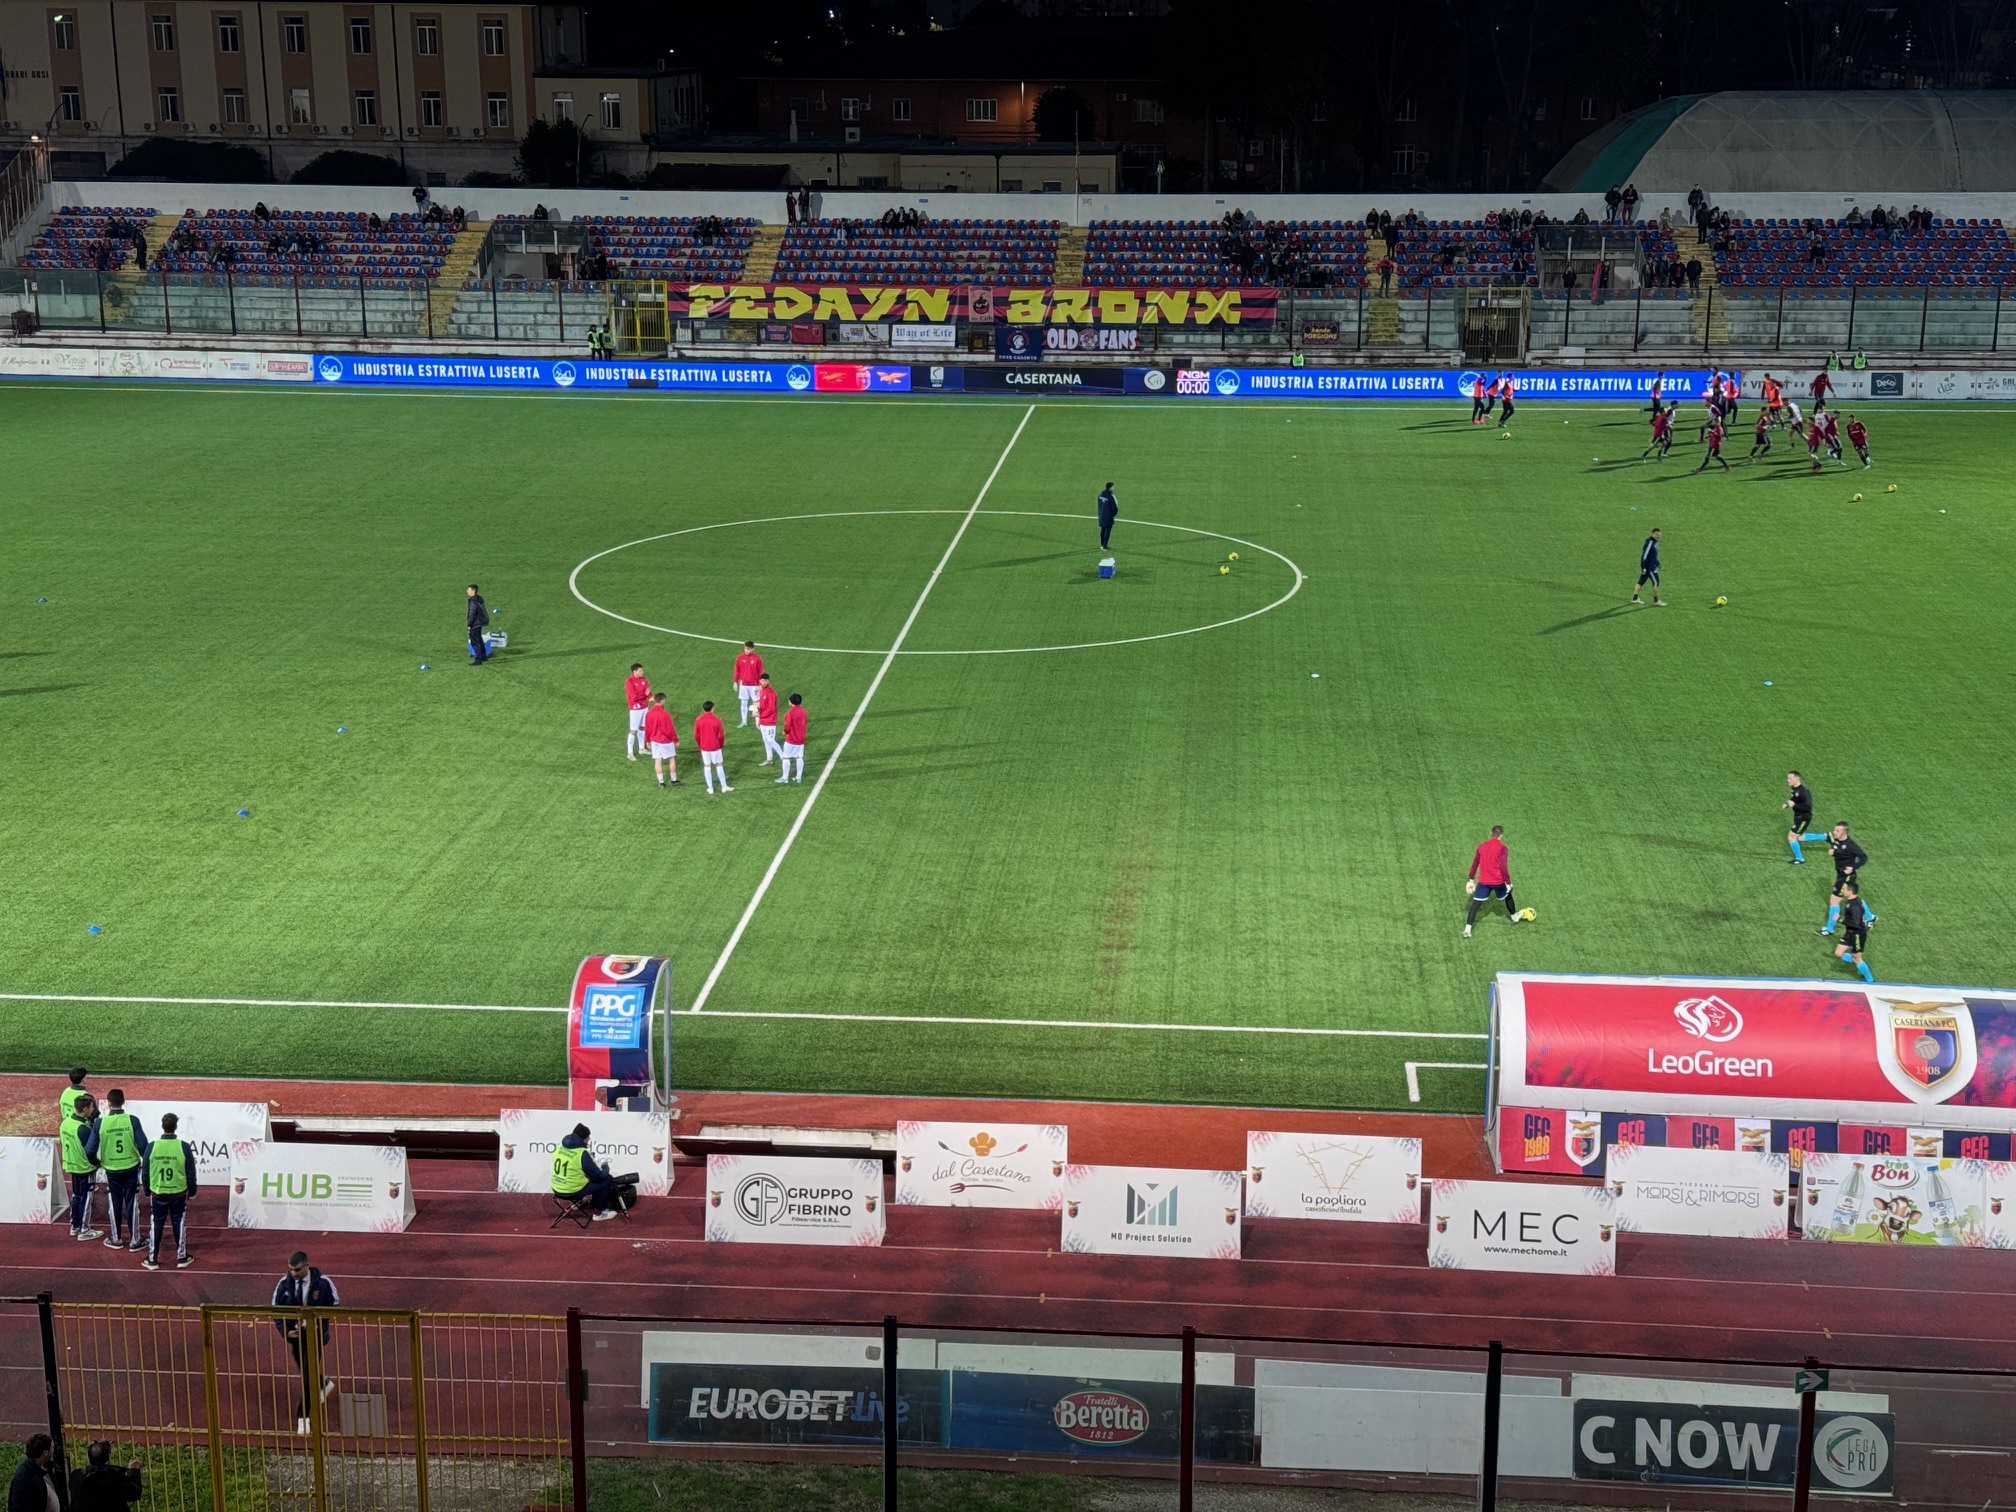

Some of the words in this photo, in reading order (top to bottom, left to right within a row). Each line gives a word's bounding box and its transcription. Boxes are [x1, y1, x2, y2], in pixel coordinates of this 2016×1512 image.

[31, 70, 49, 78] ORSI
[1006, 289, 1242, 324] BRONX
[896, 328, 917, 338] Way
[920, 329, 931, 337] of
[933, 328, 953, 337] Life
[1047, 328, 1078, 349] OLD
[1100, 328, 1137, 349] FANS
[353, 363, 412, 377] INDUSTRIA
[418, 365, 485, 378] ESTRATTIVA
[490, 366, 540, 378] LUSERTA
[585, 368, 647, 380] INDUSTRIA
[650, 368, 718, 382] ESTRATTIVA
[722, 370, 772, 383] LUSERTA
[1179, 370, 1210, 379] NGM
[1005, 372, 1082, 385] CASERTANA
[1251, 375, 1313, 389] INDUSTRIA
[1318, 376, 1387, 389] ESTRATTIVA
[1391, 376, 1444, 390] LUSERTA
[1561, 378, 1632, 391] ESTRATTIVA
[1637, 378, 1691, 391] LUERTA
[1177, 381, 1210, 394] 00:00
[590, 993, 636, 1017] PPG
[1894, 1017, 1940, 1028] CASERTANA
[1648, 1048, 1773, 1078] LeoGreen
[1915, 1066, 1941, 1075] 1908
[1524, 1113, 1551, 1140] CFC
[1617, 1119, 1646, 1146] CFC
[1692, 1121, 1719, 1149] CFC
[1788, 1126, 1816, 1152] CFC
[1863, 1129, 1891, 1155] CFC
[116, 1139, 124, 1153] 5
[1960, 1135, 1989, 1159] CFC
[554, 1158, 569, 1177] 01
[932, 1160, 957, 1182] dal
[960, 1158, 1032, 1183] Casertano
[1885, 1158, 1909, 1169] très
[159, 1167, 173, 1181] 19
[1871, 1163, 1909, 1181] Bon
[261, 1173, 333, 1199] HUB
[787, 1187, 853, 1200] GRUPPO
[1301, 1192, 1313, 1204] la
[1315, 1194, 1367, 1207] pagliara
[788, 1204, 852, 1216] FIBRINO
[1473, 1209, 1579, 1245] MEC
[1111, 1232, 1123, 1240] MD
[1125, 1233, 1155, 1242] Project
[1158, 1234, 1192, 1243] Solution
[1484, 1246, 1567, 1257] www.mechome.it
[1083, 1394, 1119, 1406] Fratelli
[1059, 1400, 1145, 1431] Beretta
[1089, 1430, 1114, 1439] 1812
[1579, 1415, 1616, 1464] C
[1635, 1417, 1781, 1471] NOW
[1847, 1438, 1877, 1453] LEGA
[1847, 1452, 1877, 1472] PRO
